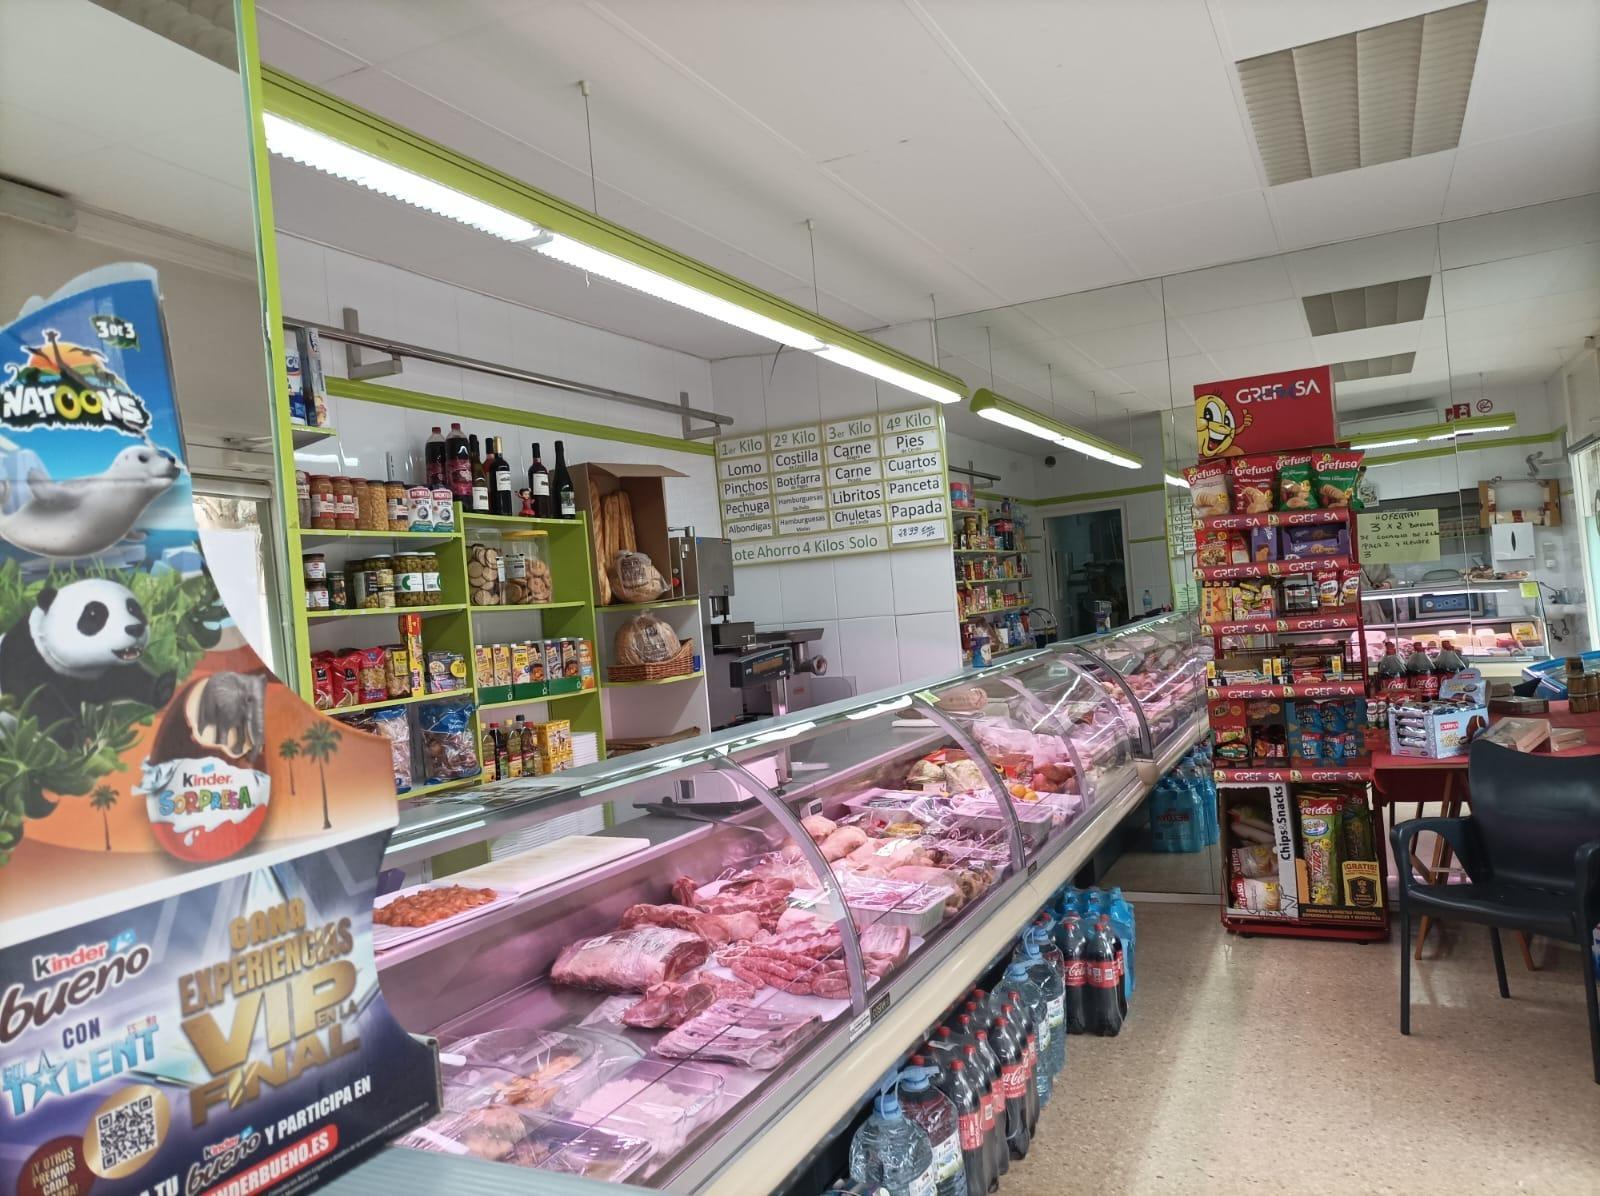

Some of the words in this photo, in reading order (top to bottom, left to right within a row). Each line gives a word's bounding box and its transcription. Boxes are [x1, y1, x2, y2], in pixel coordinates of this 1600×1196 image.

[96, 321, 109, 338] 3
[124, 322, 136, 338] 3
[2, 384, 145, 425] NATOONS
[828, 426, 845, 440] 3er
[848, 420, 872, 436] Kilo
[886, 417, 901, 431] 4º
[905, 413, 932, 428] Kilo
[739, 438, 762, 453] Kilo
[774, 433, 788, 448] 2º
[792, 430, 816, 445] Kilo
[896, 435, 925, 450] Pies
[775, 450, 819, 467] Costilla
[833, 442, 872, 458] Carne
[728, 462, 762, 477] Lomo
[888, 456, 937, 472] Cuartos
[1234, 465, 1273, 476] Grefusa
[1276, 454, 1312, 471] Grefusa
[1316, 459, 1358, 473] Grefusa
[776, 473, 821, 488] Botifarra
[835, 465, 872, 480] Carne
[1187, 467, 1222, 485] Grefusa
[724, 479, 769, 496] Pinchos
[889, 477, 940, 495] Panceta
[778, 494, 824, 506] Hamburguesas
[832, 488, 881, 505] Libritos
[726, 500, 770, 515] Pechuga
[834, 508, 882, 523] Chuletas
[891, 499, 942, 520] Papada
[729, 522, 772, 535] Albondigas
[780, 515, 826, 527] Hamburguesas
[1370, 523, 1381, 533] 3
[1396, 522, 1403, 530] 2
[731, 548, 755, 562] ote
[757, 541, 800, 559] Ahorro
[803, 541, 811, 554] 4
[814, 537, 844, 554] Kilos
[849, 534, 878, 549] Solo
[1363, 550, 1372, 559] 3
[159, 785, 253, 816] SORPRESA
[1273, 785, 1292, 861] Chips&Snacks
[230, 896, 305, 950] GANA
[179, 916, 353, 1017] EXPERIENCIAS
[0, 947, 150, 1044] bueno
[180, 960, 358, 1076] VIP
[315, 1007, 336, 1028] EN
[340, 999, 359, 1020] LA
[62, 1016, 101, 1050] CON
[190, 1022, 361, 1128] FINAL
[154, 1174, 179, 1196] TU
[264, 1125, 277, 1146] Y
[277, 1089, 353, 1141] PARTICIPA
[354, 1075, 372, 1100] EN
[43, 1146, 75, 1171] OTROS
[32, 1160, 76, 1190] PREMIOS
